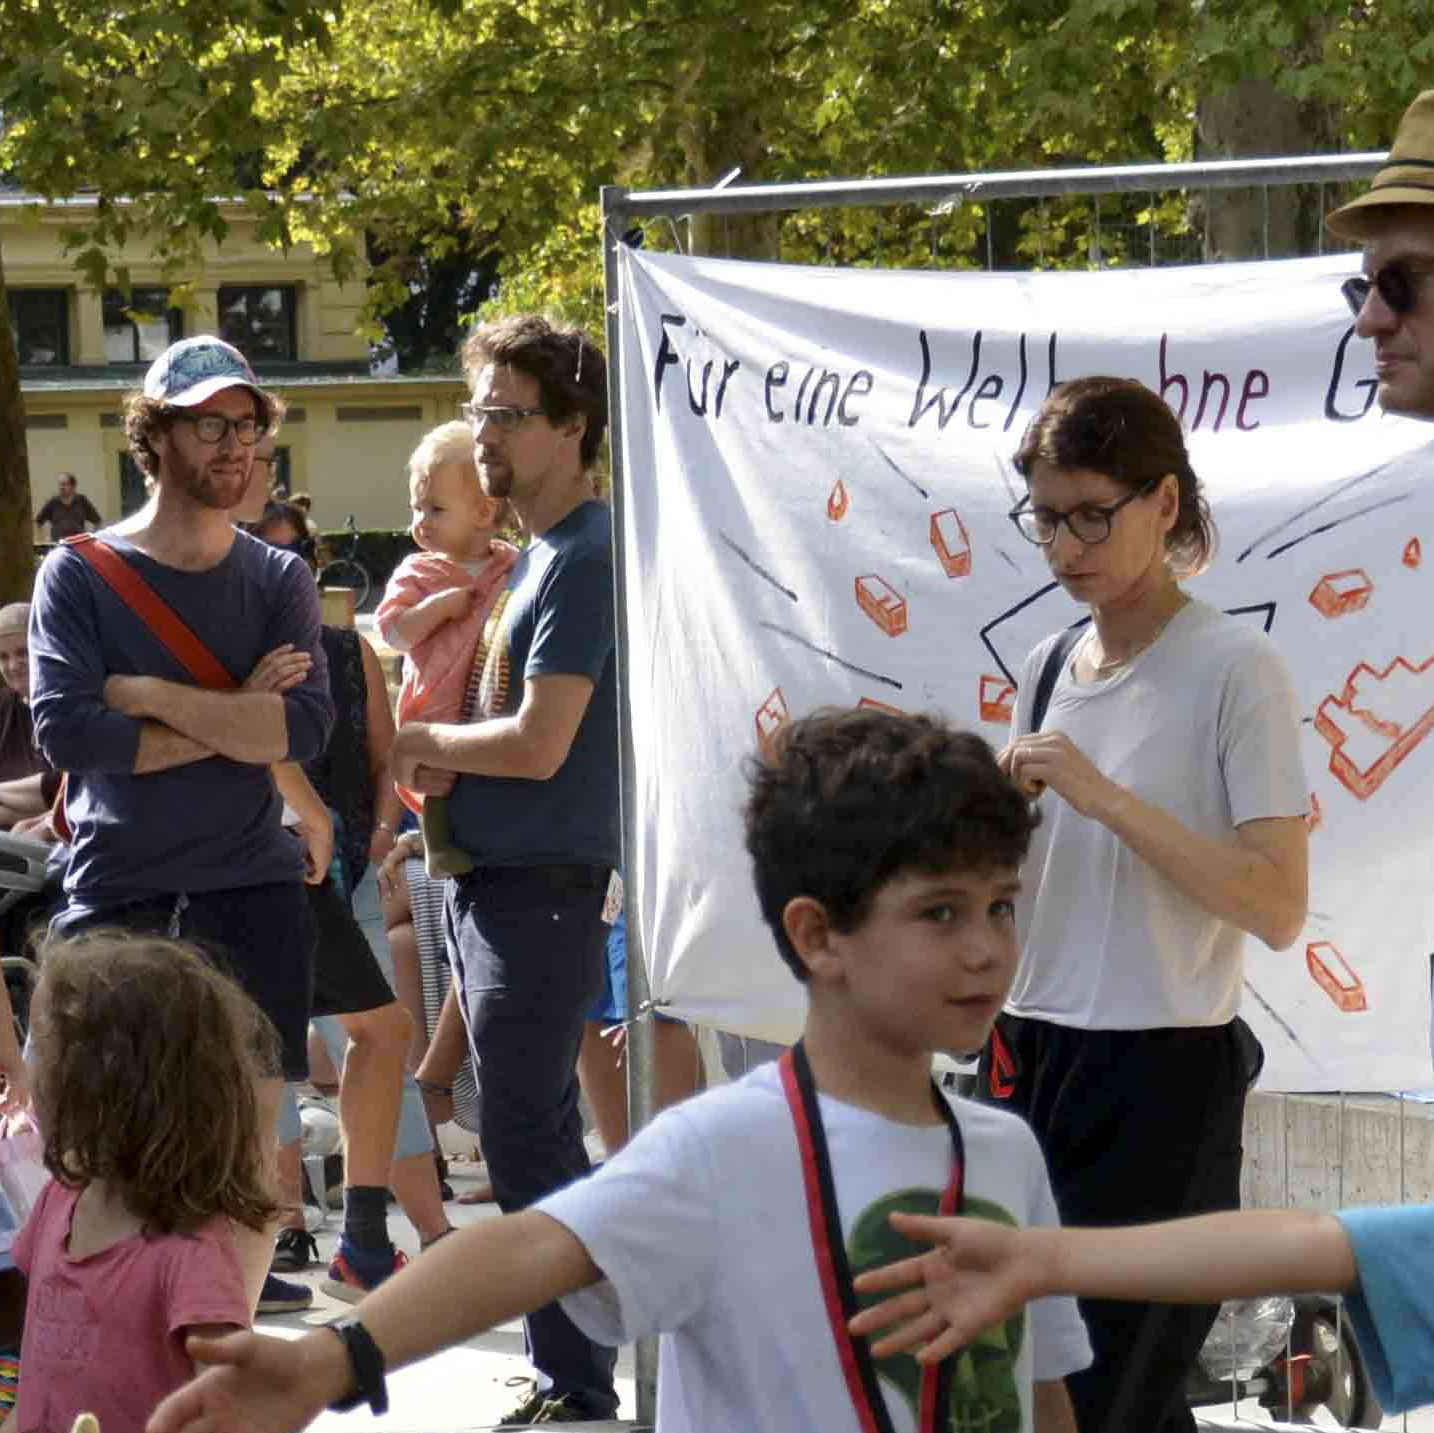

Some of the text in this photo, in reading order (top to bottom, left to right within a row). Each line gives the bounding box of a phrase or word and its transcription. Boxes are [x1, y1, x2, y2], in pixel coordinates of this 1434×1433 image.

[654, 312, 741, 421] Für
[765, 350, 874, 427] eine
[1143, 332, 1270, 433] hne
